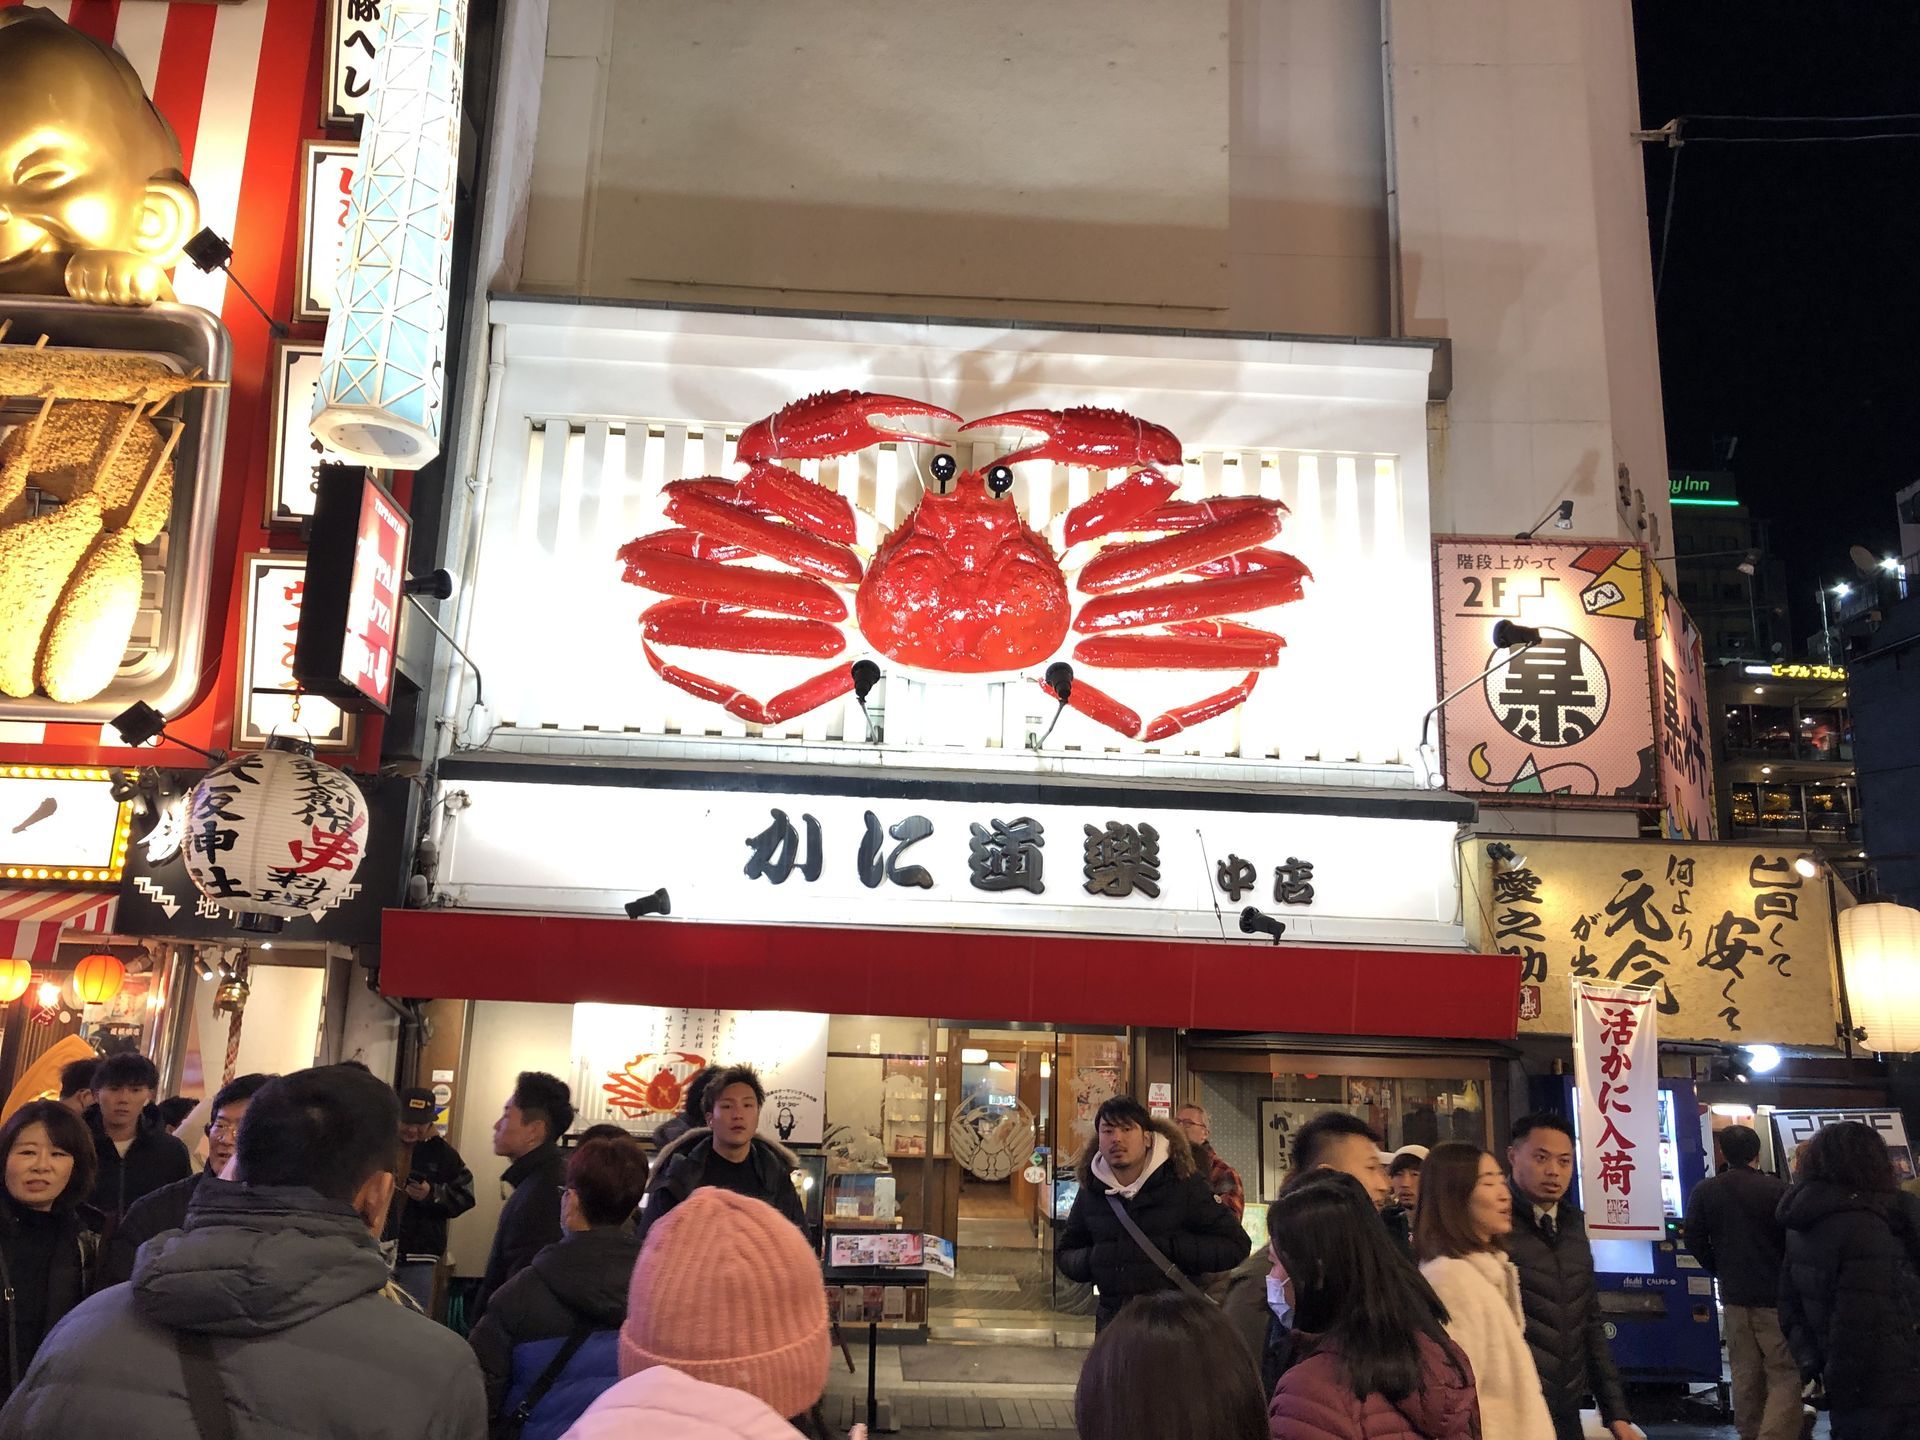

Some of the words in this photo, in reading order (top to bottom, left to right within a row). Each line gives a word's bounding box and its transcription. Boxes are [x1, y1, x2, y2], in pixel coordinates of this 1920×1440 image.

[1685, 475, 1710, 491] Inn
[1457, 553, 1558, 571] 階段上がって
[1463, 576, 1507, 608] 2F
[1216, 852, 1314, 905] 中店
[1666, 854, 1696, 950] 何より
[1749, 854, 1803, 977] 旨くて
[1493, 868, 1548, 983] 愛之助
[1570, 913, 1602, 986] が出
[1697, 910, 1764, 1031] 安くて
[1596, 1007, 1638, 1196] 活かに入荷
